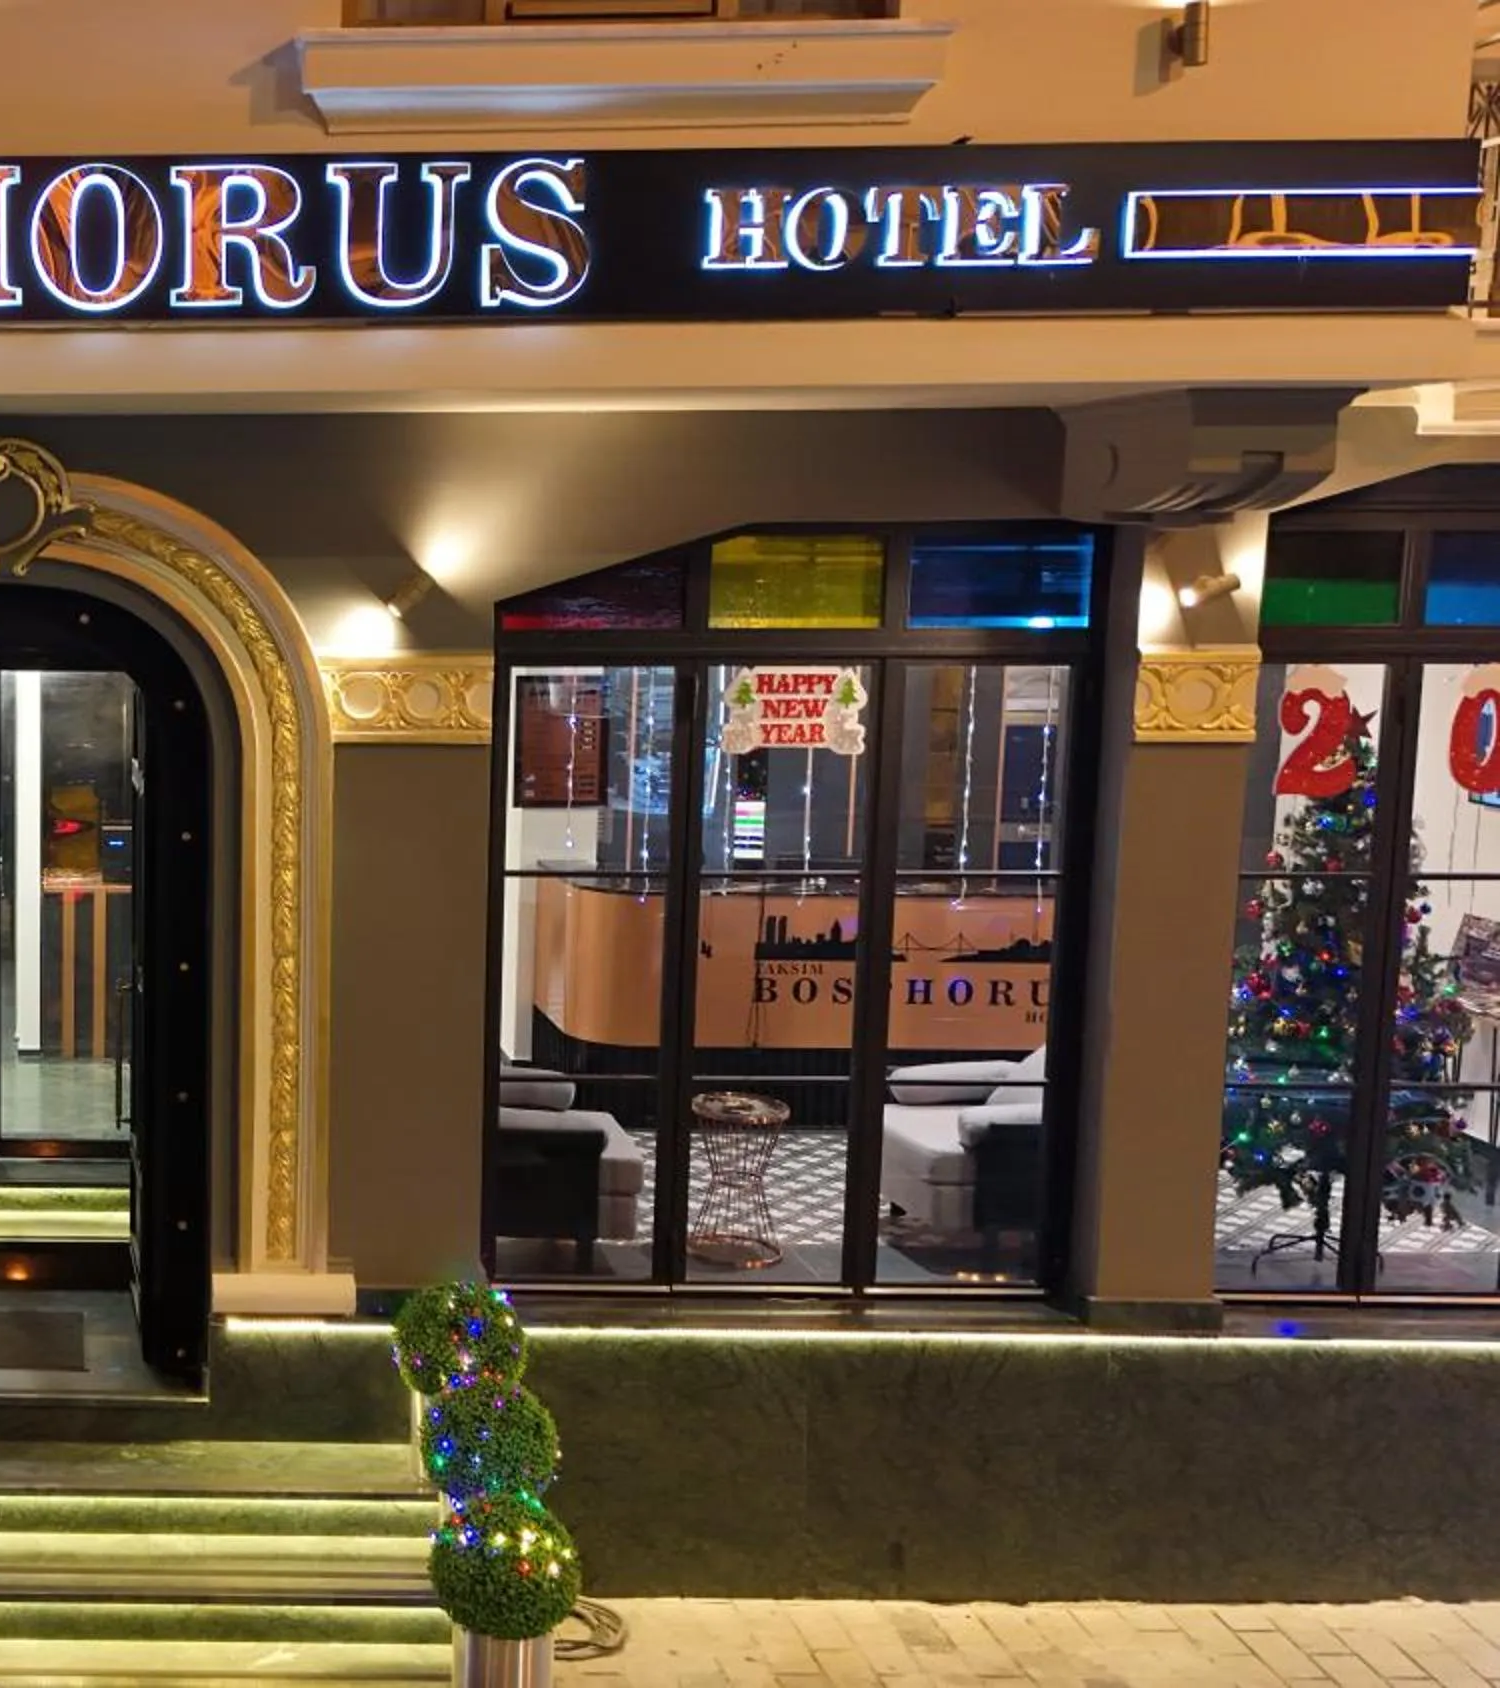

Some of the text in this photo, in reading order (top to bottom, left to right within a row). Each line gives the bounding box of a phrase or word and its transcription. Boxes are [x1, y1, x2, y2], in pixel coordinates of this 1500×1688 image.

[700, 183, 1100, 272] HOTEL
[756, 673, 838, 694] HAPPY
[762, 699, 829, 718] NEW
[760, 723, 826, 743] YEAR
